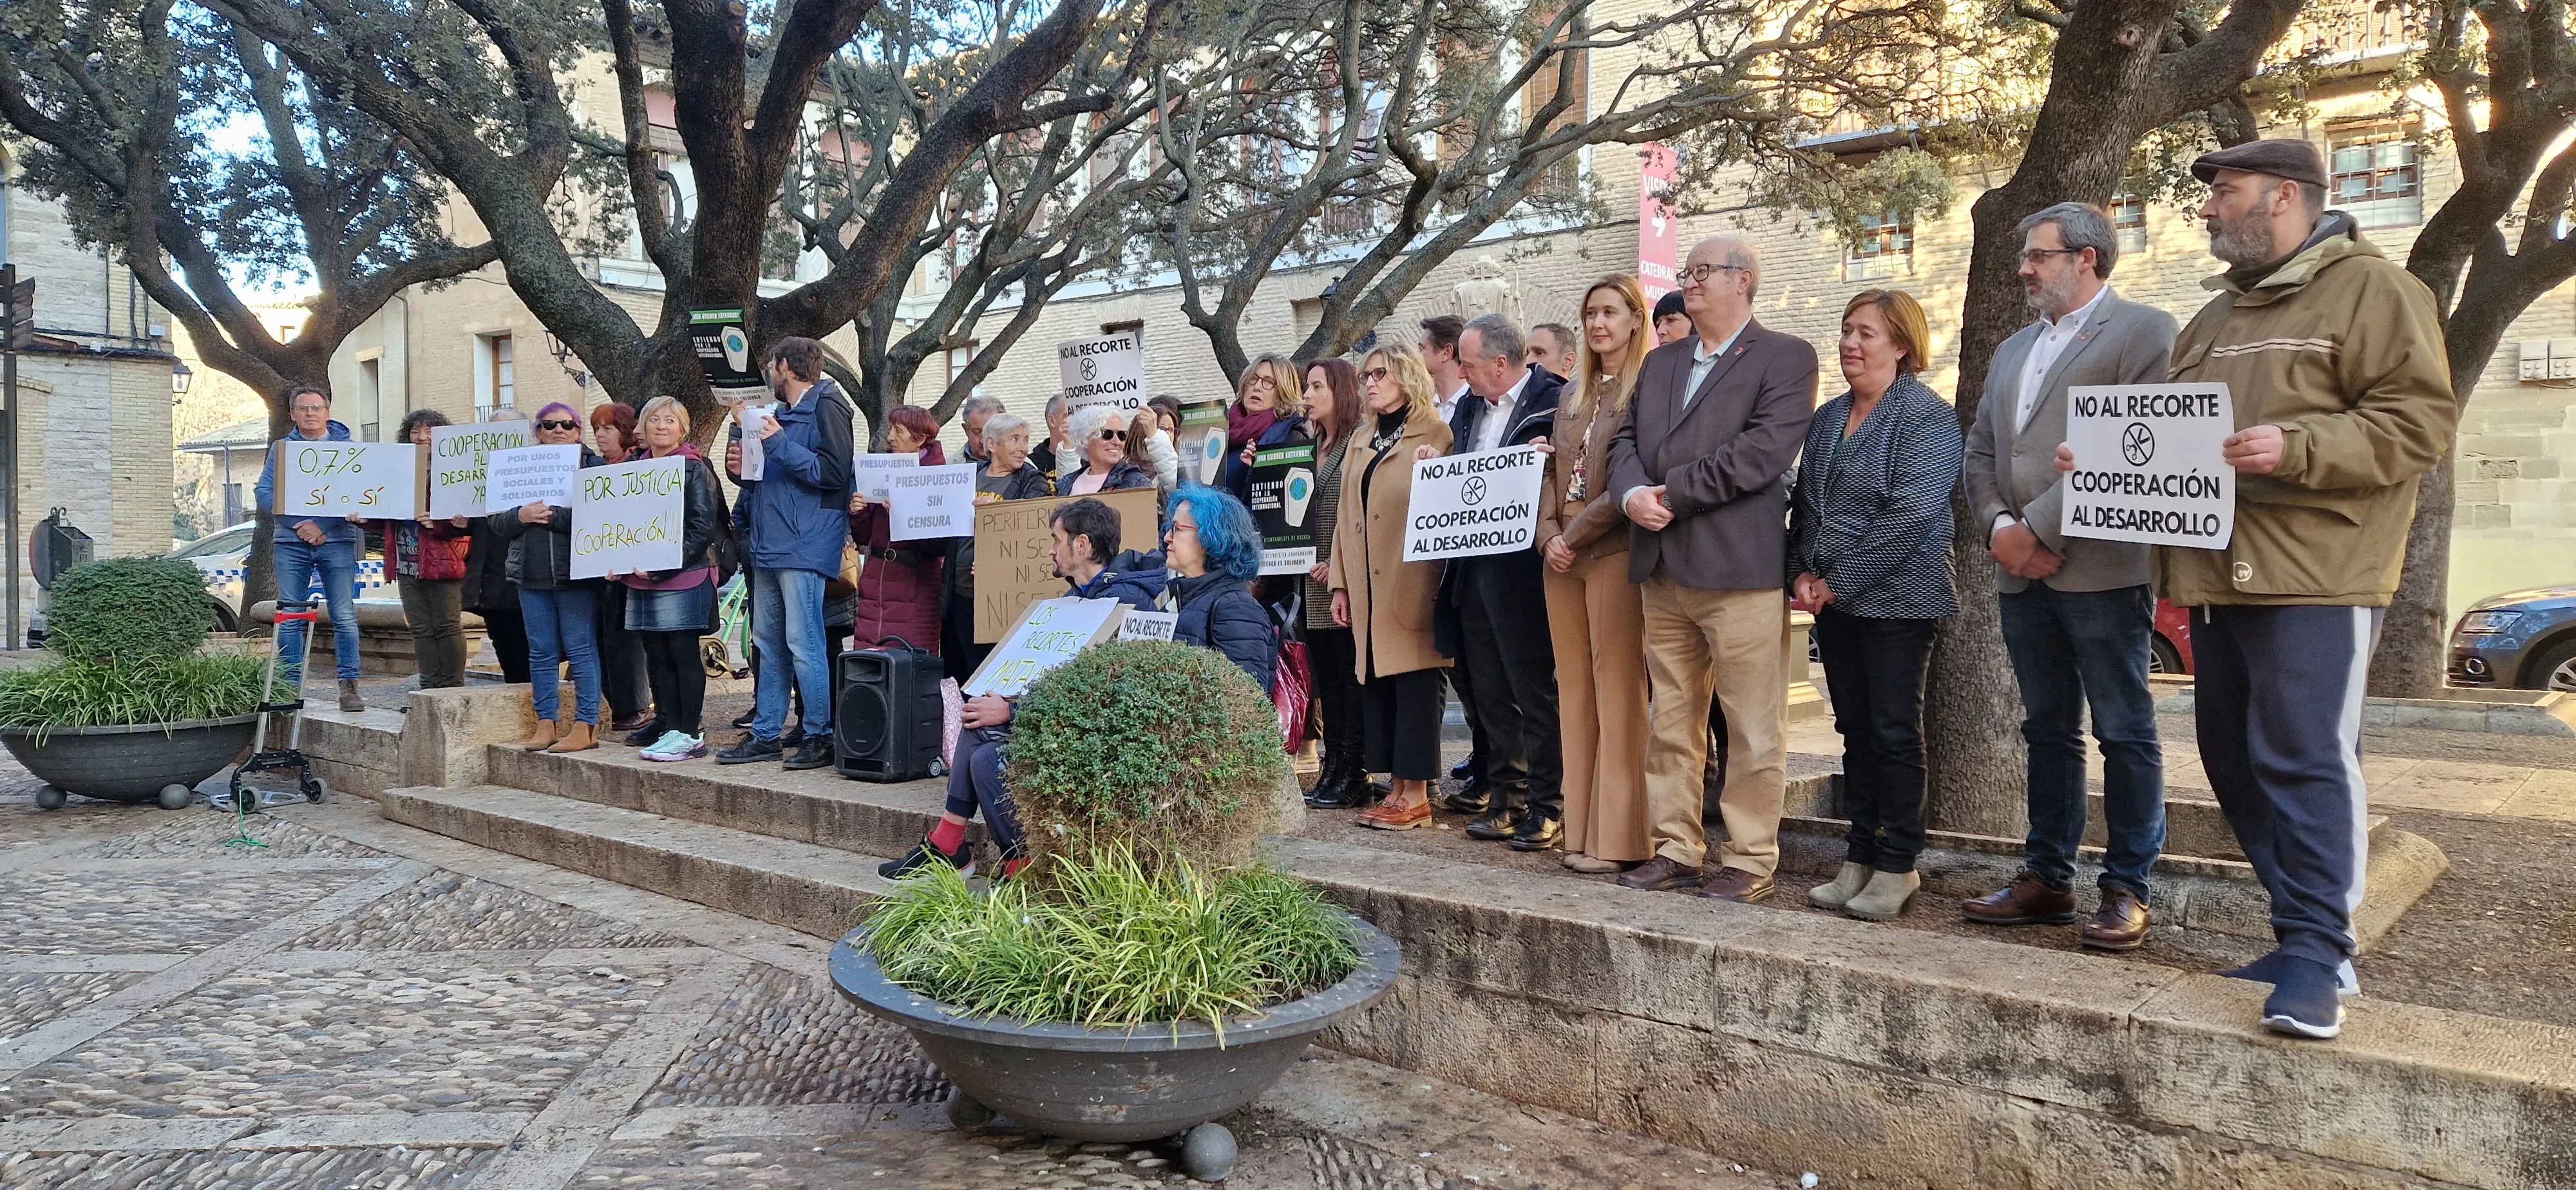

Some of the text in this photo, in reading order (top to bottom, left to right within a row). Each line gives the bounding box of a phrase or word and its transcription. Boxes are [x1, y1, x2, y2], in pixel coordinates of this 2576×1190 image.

[1640, 260, 1674, 281] CATEDRAL
[1060, 338, 1132, 360] NO AL RECORTE
[1065, 376, 1137, 399] COOPERACIÓN
[2074, 394, 2219, 417] NO AL RECORTE
[439, 429, 523, 457] COOPERACIÓN
[299, 447, 367, 477] 0,7%
[473, 452, 487, 467] AL
[507, 452, 561, 463] POR UNOS
[860, 459, 914, 468] PRESUPUESTOS
[1421, 450, 1535, 480] NO AL RECORTE
[494, 464, 577, 477] PRESUPUESTOS
[896, 472, 969, 488] PRESUPUESTOS
[502, 477, 554, 488] SOCIALES
[585, 476, 616, 503] POR
[1251, 480, 1283, 491] ENTIERRO
[2072, 468, 2221, 499] COOPERACIÓN
[501, 489, 564, 501] SOLIDARIOS
[927, 495, 943, 507] SIN
[1251, 495, 1278, 504] COOPERACIÓN
[907, 515, 951, 529] CENSURA
[1415, 500, 1530, 530] COOPERACIÓN
[2071, 505, 2221, 537] AL DESARROLLO
[999, 540, 1018, 558] NI
[1412, 528, 1528, 553] AL DESARROLLO
[1016, 565, 1030, 583] NI
[987, 590, 1009, 629] NI
[1028, 605, 1058, 625] LOS
[1123, 616, 1172, 638] NO AL RECORTE
[1021, 631, 1086, 652] RECORTES
